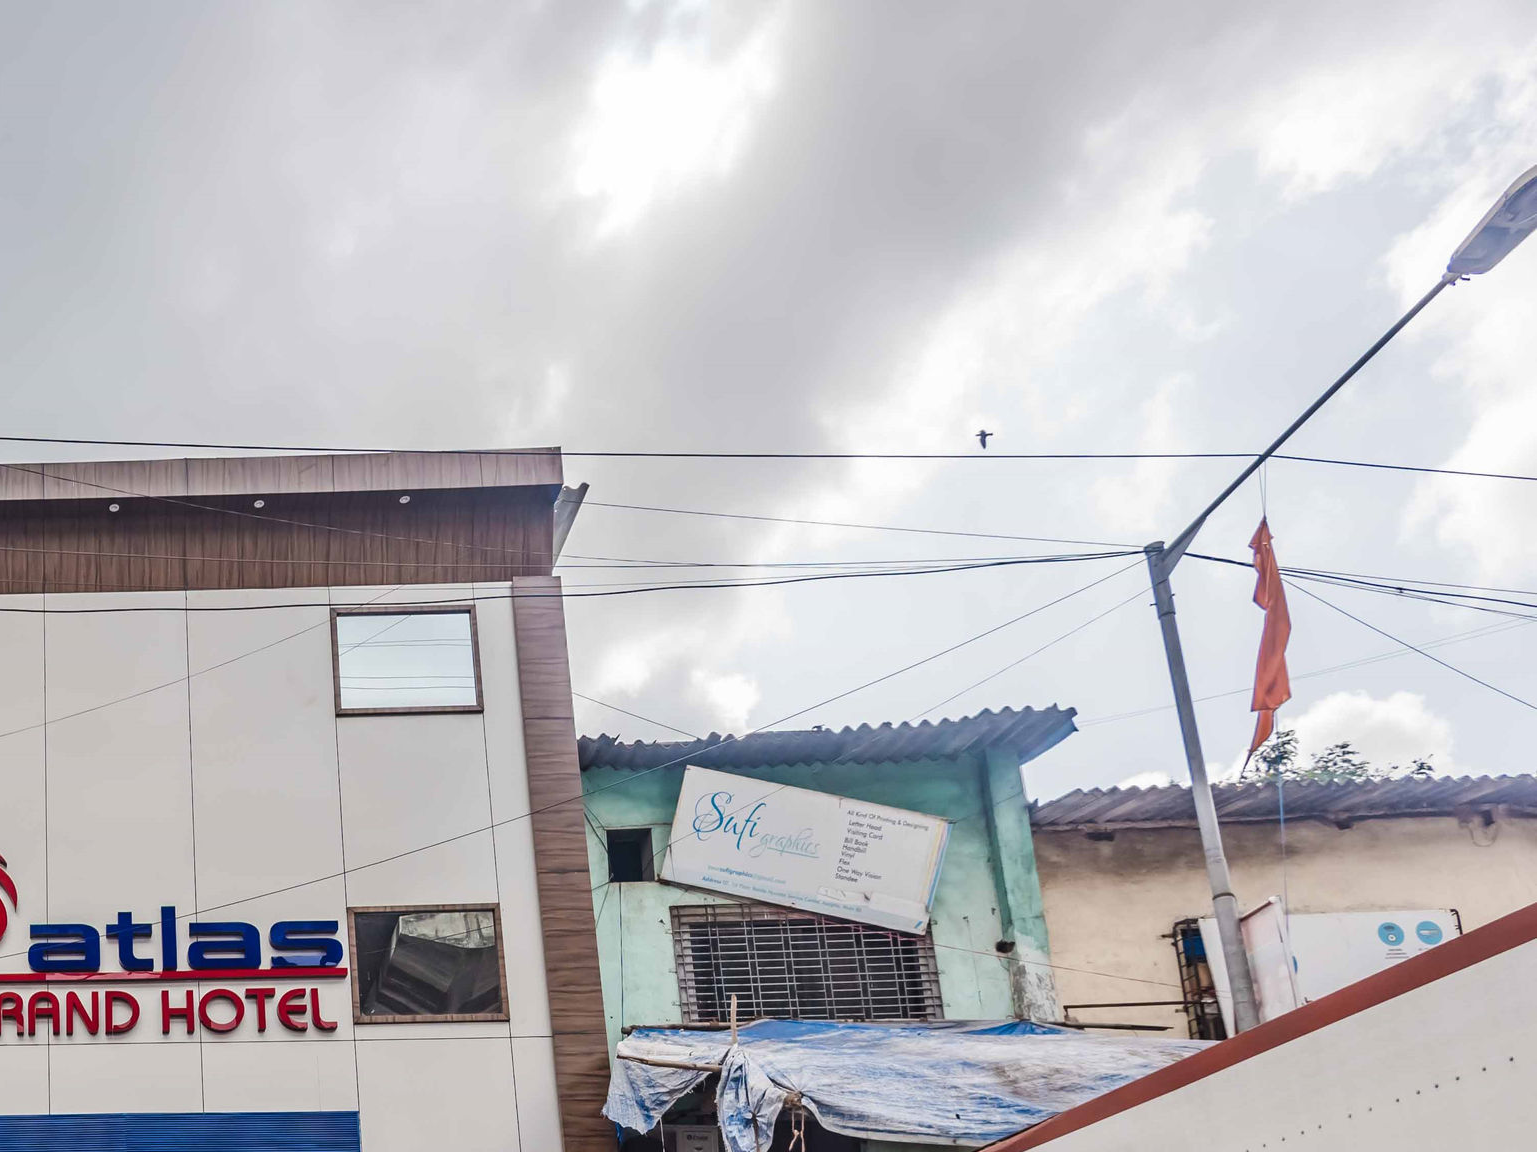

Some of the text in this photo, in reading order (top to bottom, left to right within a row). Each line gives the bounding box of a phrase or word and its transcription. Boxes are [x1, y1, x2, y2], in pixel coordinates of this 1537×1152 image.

[692, 791, 766, 850] Sufi
[869, 832, 883, 840] Card
[28, 906, 343, 972] atlas
[161, 987, 338, 1034] HOTEL
